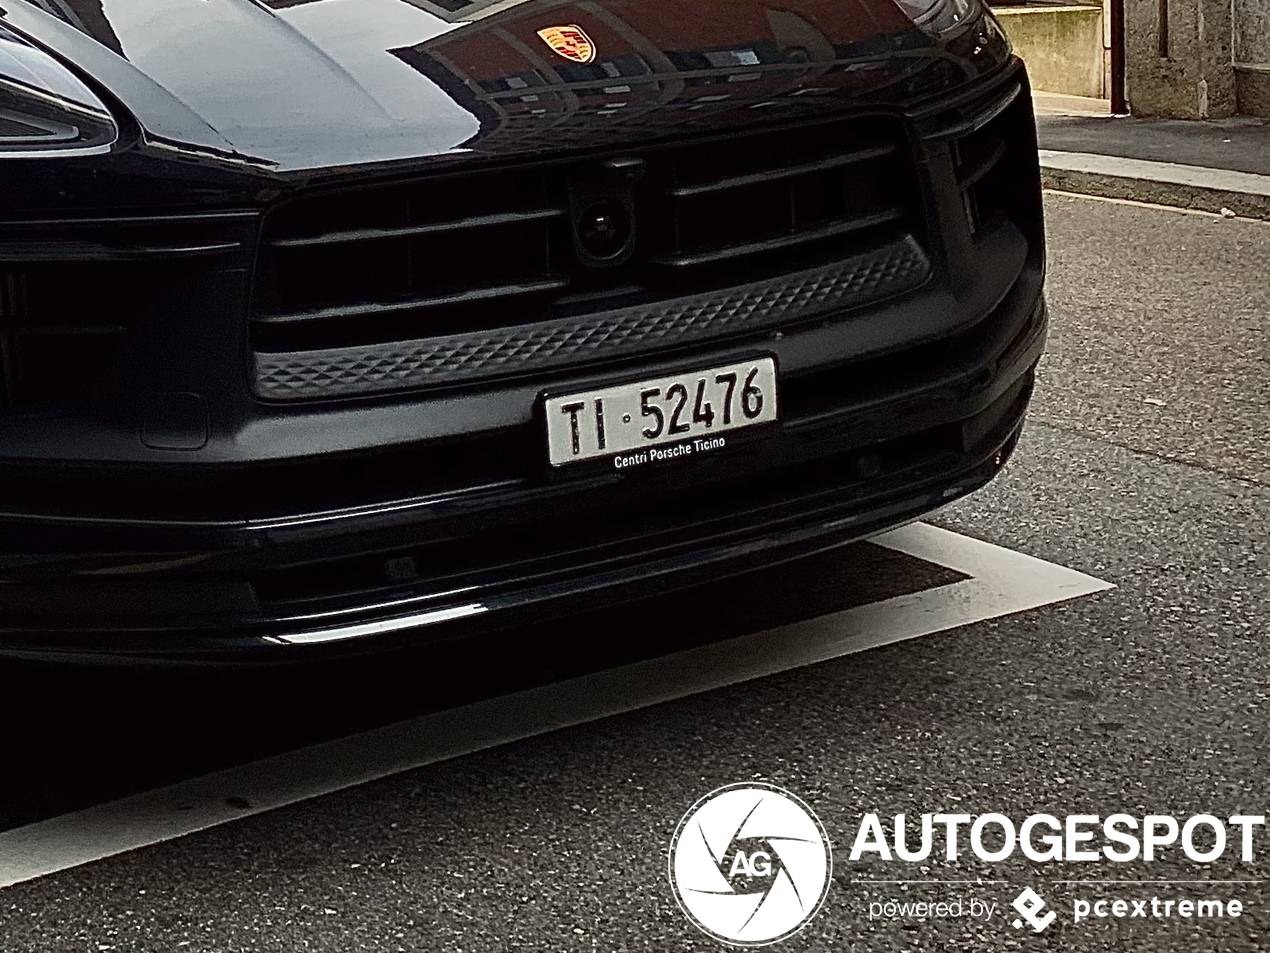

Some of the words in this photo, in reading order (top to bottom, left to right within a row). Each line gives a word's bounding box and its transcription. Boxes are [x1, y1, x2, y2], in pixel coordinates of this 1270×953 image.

[640, 366, 764, 439] 52476
[614, 454, 648, 469] Centri
[650, 444, 692, 462] Porsche
[693, 437, 726, 453] Ticino
